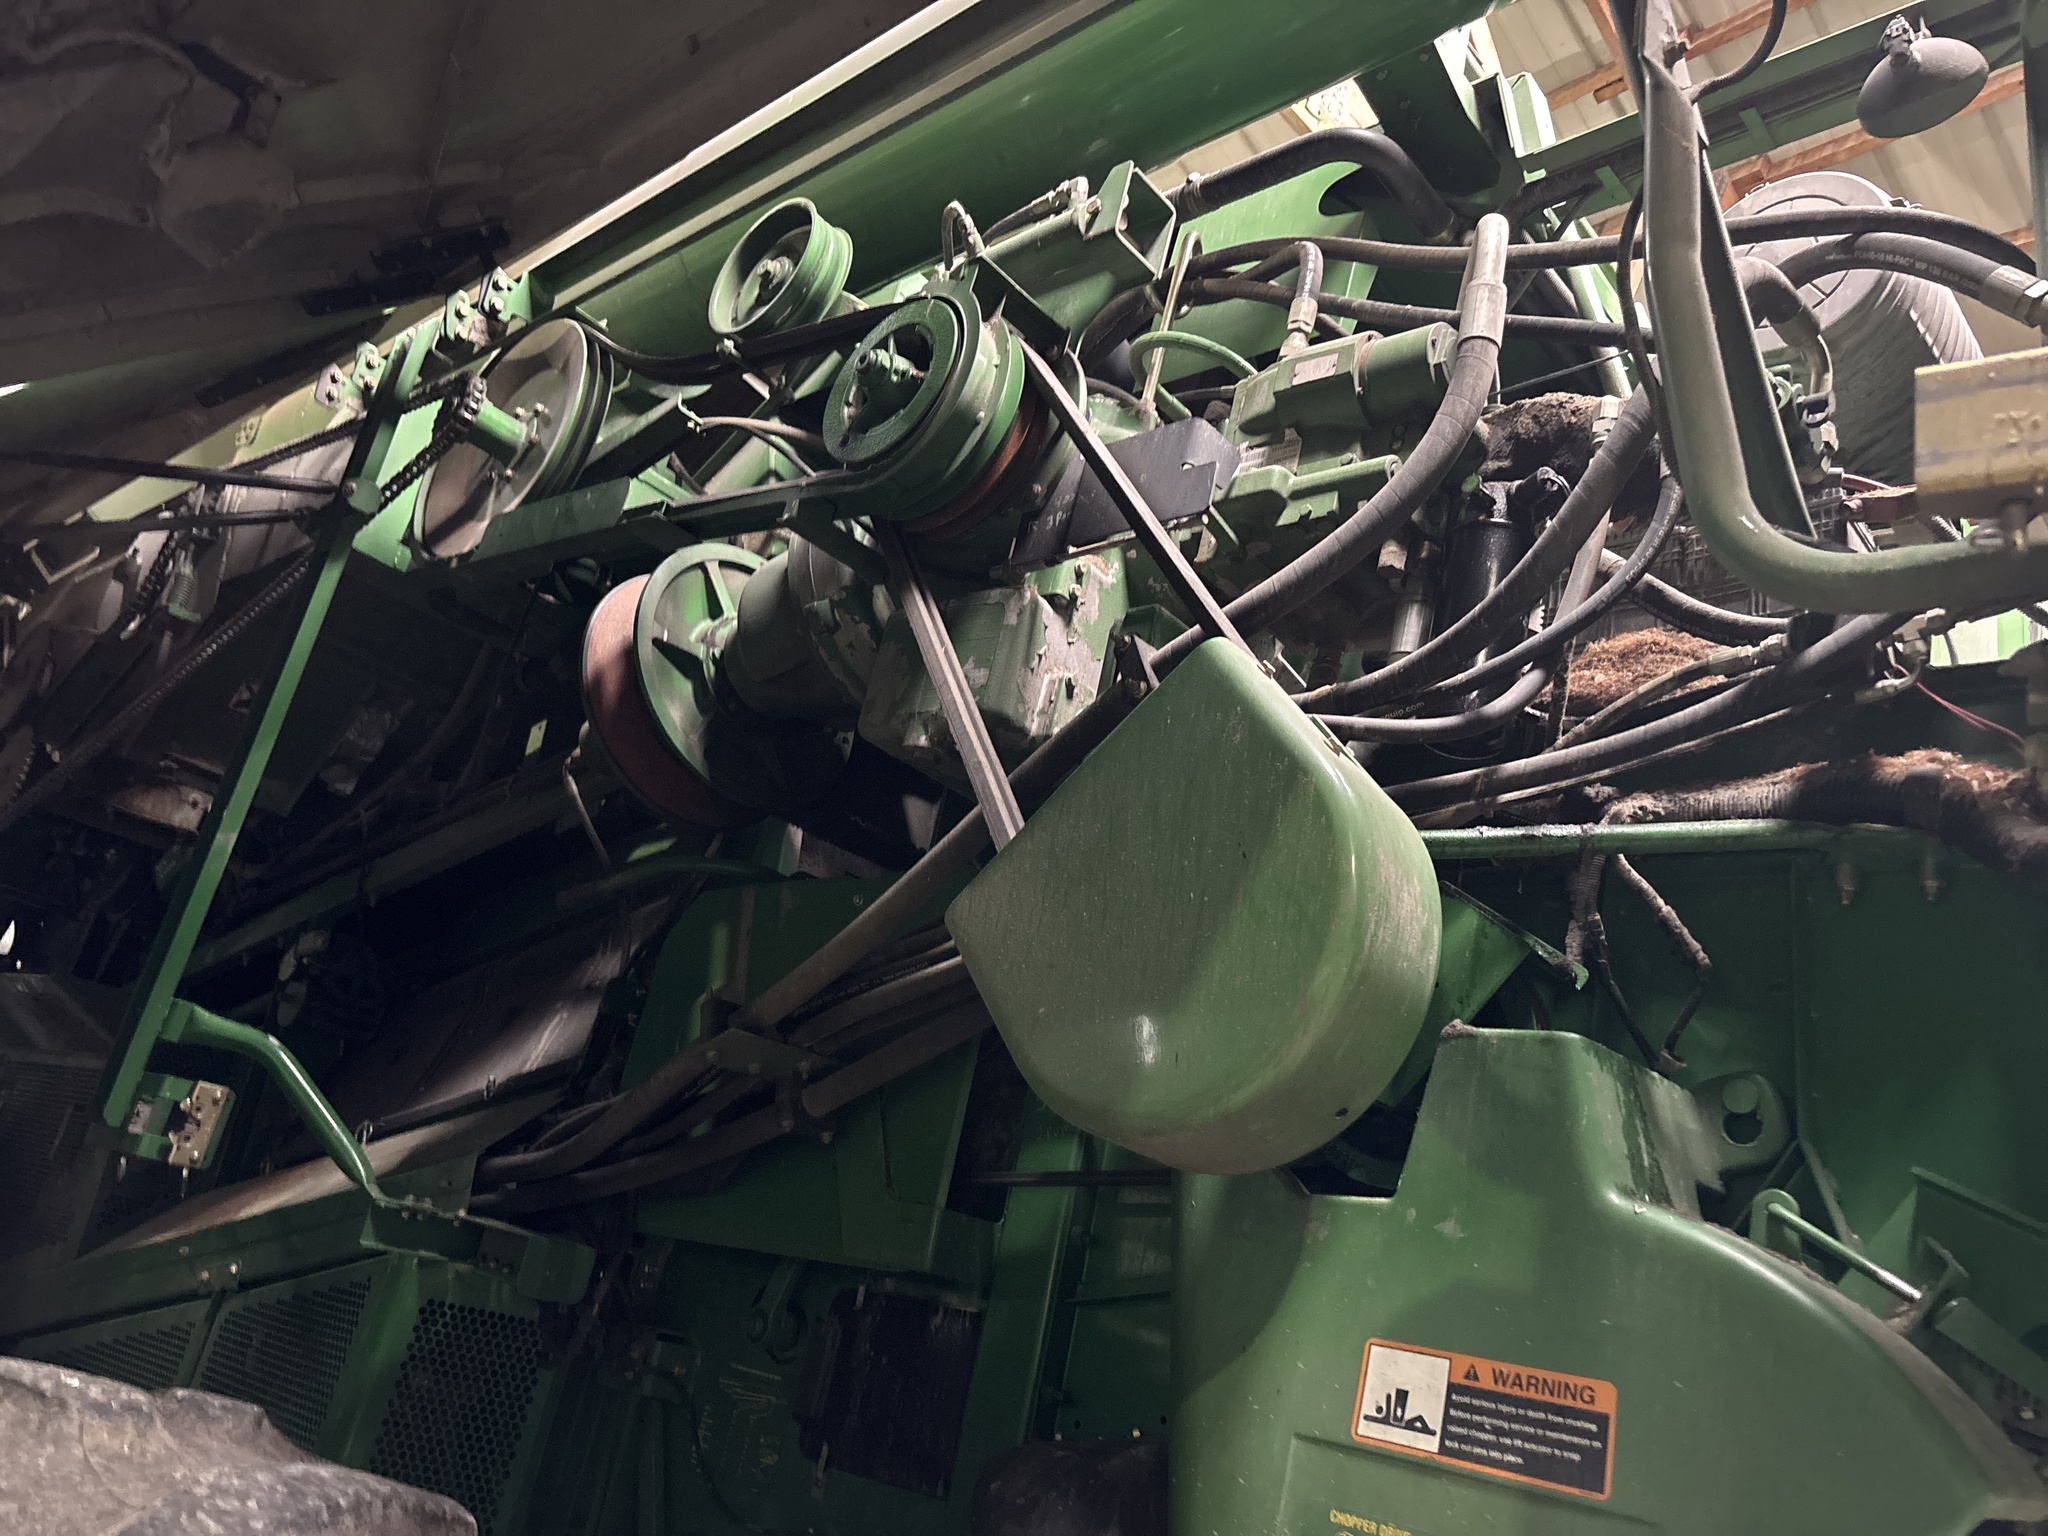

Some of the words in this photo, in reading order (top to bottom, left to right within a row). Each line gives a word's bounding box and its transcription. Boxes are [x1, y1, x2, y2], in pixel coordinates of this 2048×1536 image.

[1492, 1367, 1596, 1405] WARNING
[1451, 1393, 1471, 1405] Avoid
[1471, 1398, 1496, 1410] serious
[1497, 1402, 1517, 1415] injury
[1517, 1407, 1526, 1415] or
[1526, 1408, 1547, 1420] death
[1547, 1412, 1565, 1424] from
[1447, 1424, 1468, 1436] raised
[1498, 1435, 1512, 1446] use
[1512, 1437, 1523, 1448] lift
[1553, 1448, 1562, 1457] to
[1449, 1407, 1471, 1420] Before
[1471, 1413, 1510, 1431] performing
[1510, 1421, 1535, 1435] service
[1535, 1427, 1545, 1436] or
[1545, 1429, 1591, 1447] maintenance
[1591, 1440, 1603, 1449] on
[1445, 1438, 1459, 1449] lock
[1459, 1443, 1472, 1452] out
[1330, 1509, 1377, 1535] CHOPPER
